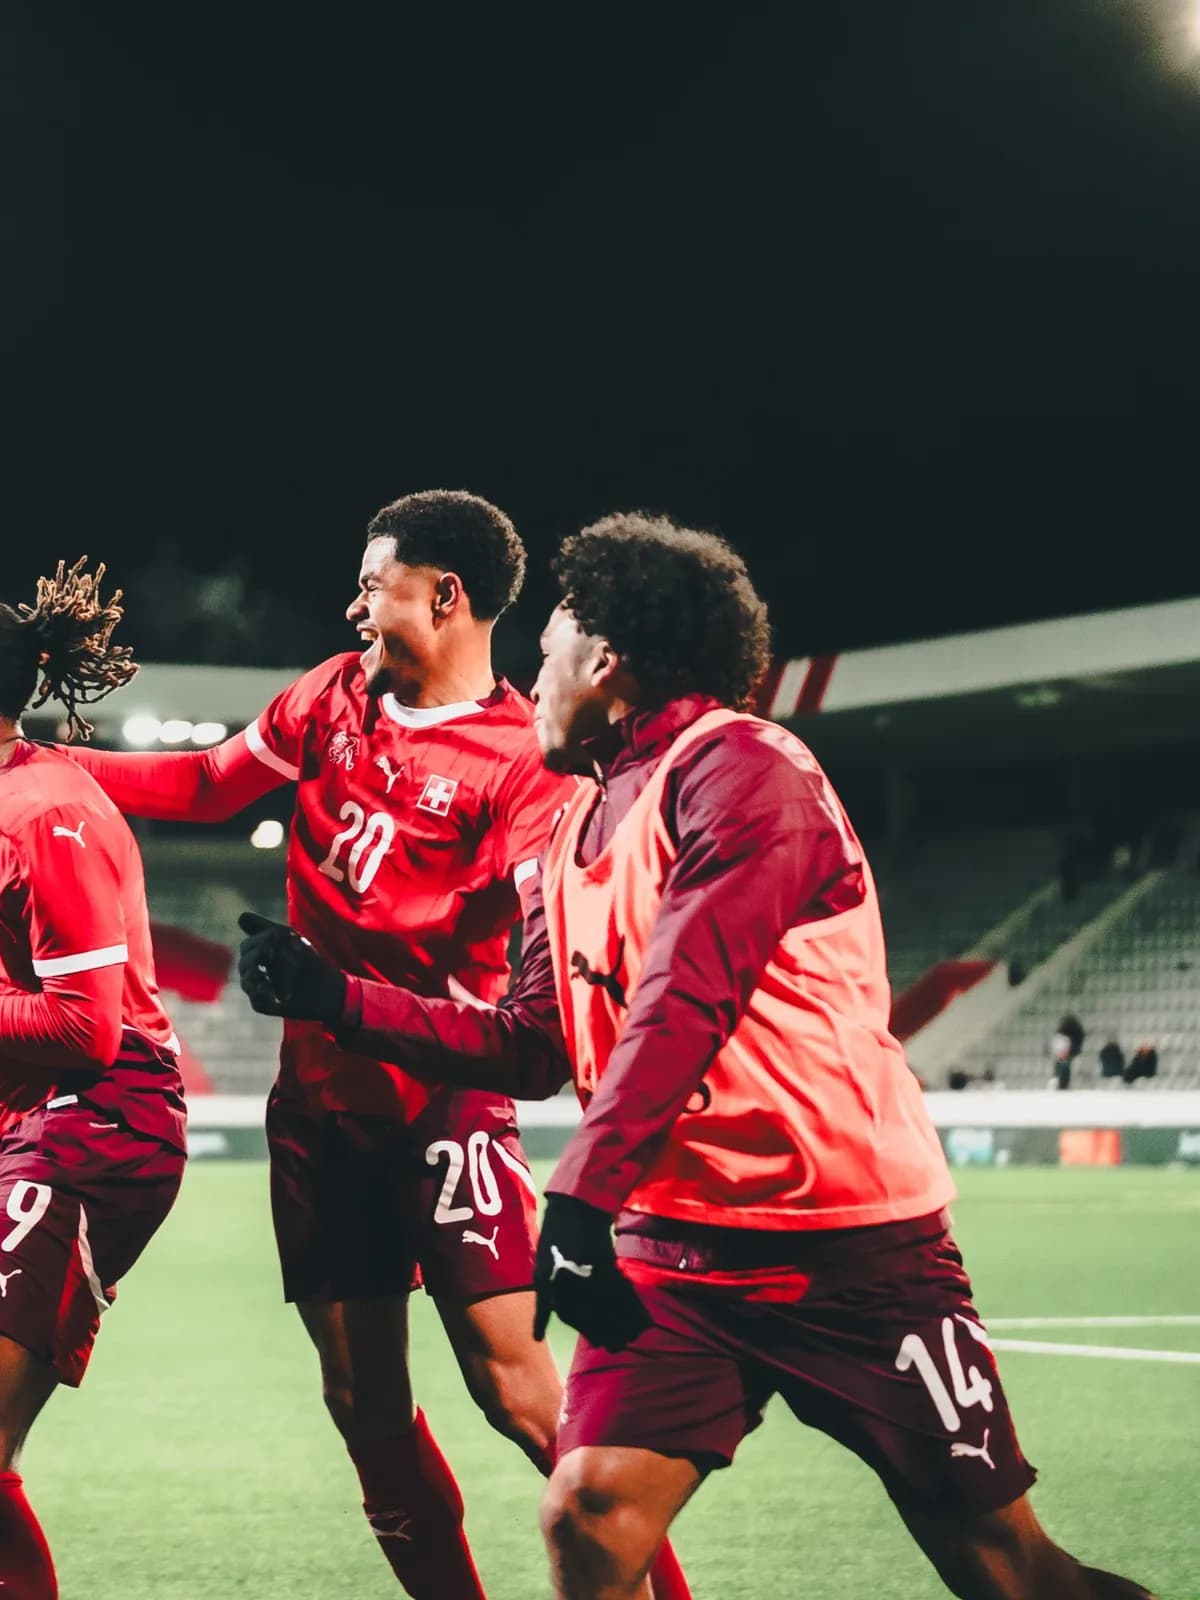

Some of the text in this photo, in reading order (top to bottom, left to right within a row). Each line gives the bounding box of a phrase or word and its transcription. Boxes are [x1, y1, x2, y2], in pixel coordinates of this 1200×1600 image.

[318, 801, 395, 894] 20
[1, 1180, 52, 1252] 9
[425, 1130, 502, 1225] 20
[895, 1316, 994, 1433] 14
